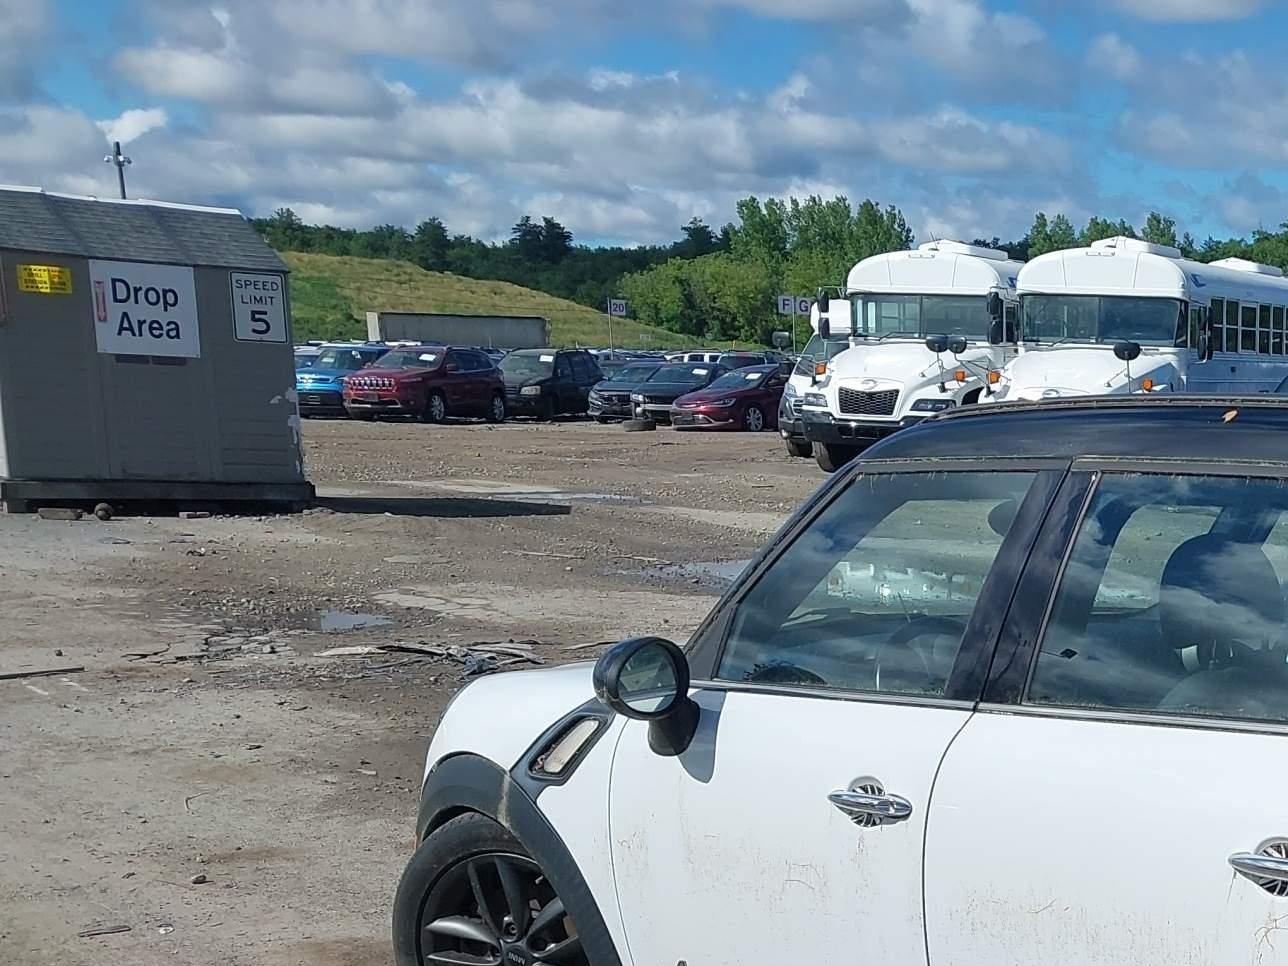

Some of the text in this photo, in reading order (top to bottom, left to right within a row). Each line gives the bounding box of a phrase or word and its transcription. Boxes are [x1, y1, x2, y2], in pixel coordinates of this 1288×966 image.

[235, 279, 279, 291] SPEED
[110, 277, 179, 312] Drop
[241, 294, 275, 306] LIMIT
[612, 302, 625, 313] 20
[782, 298, 791, 312] F
[798, 299, 809, 313] G
[117, 311, 181, 340] Area
[250, 309, 271, 335] 5
[508, 951, 526, 965] MINI
